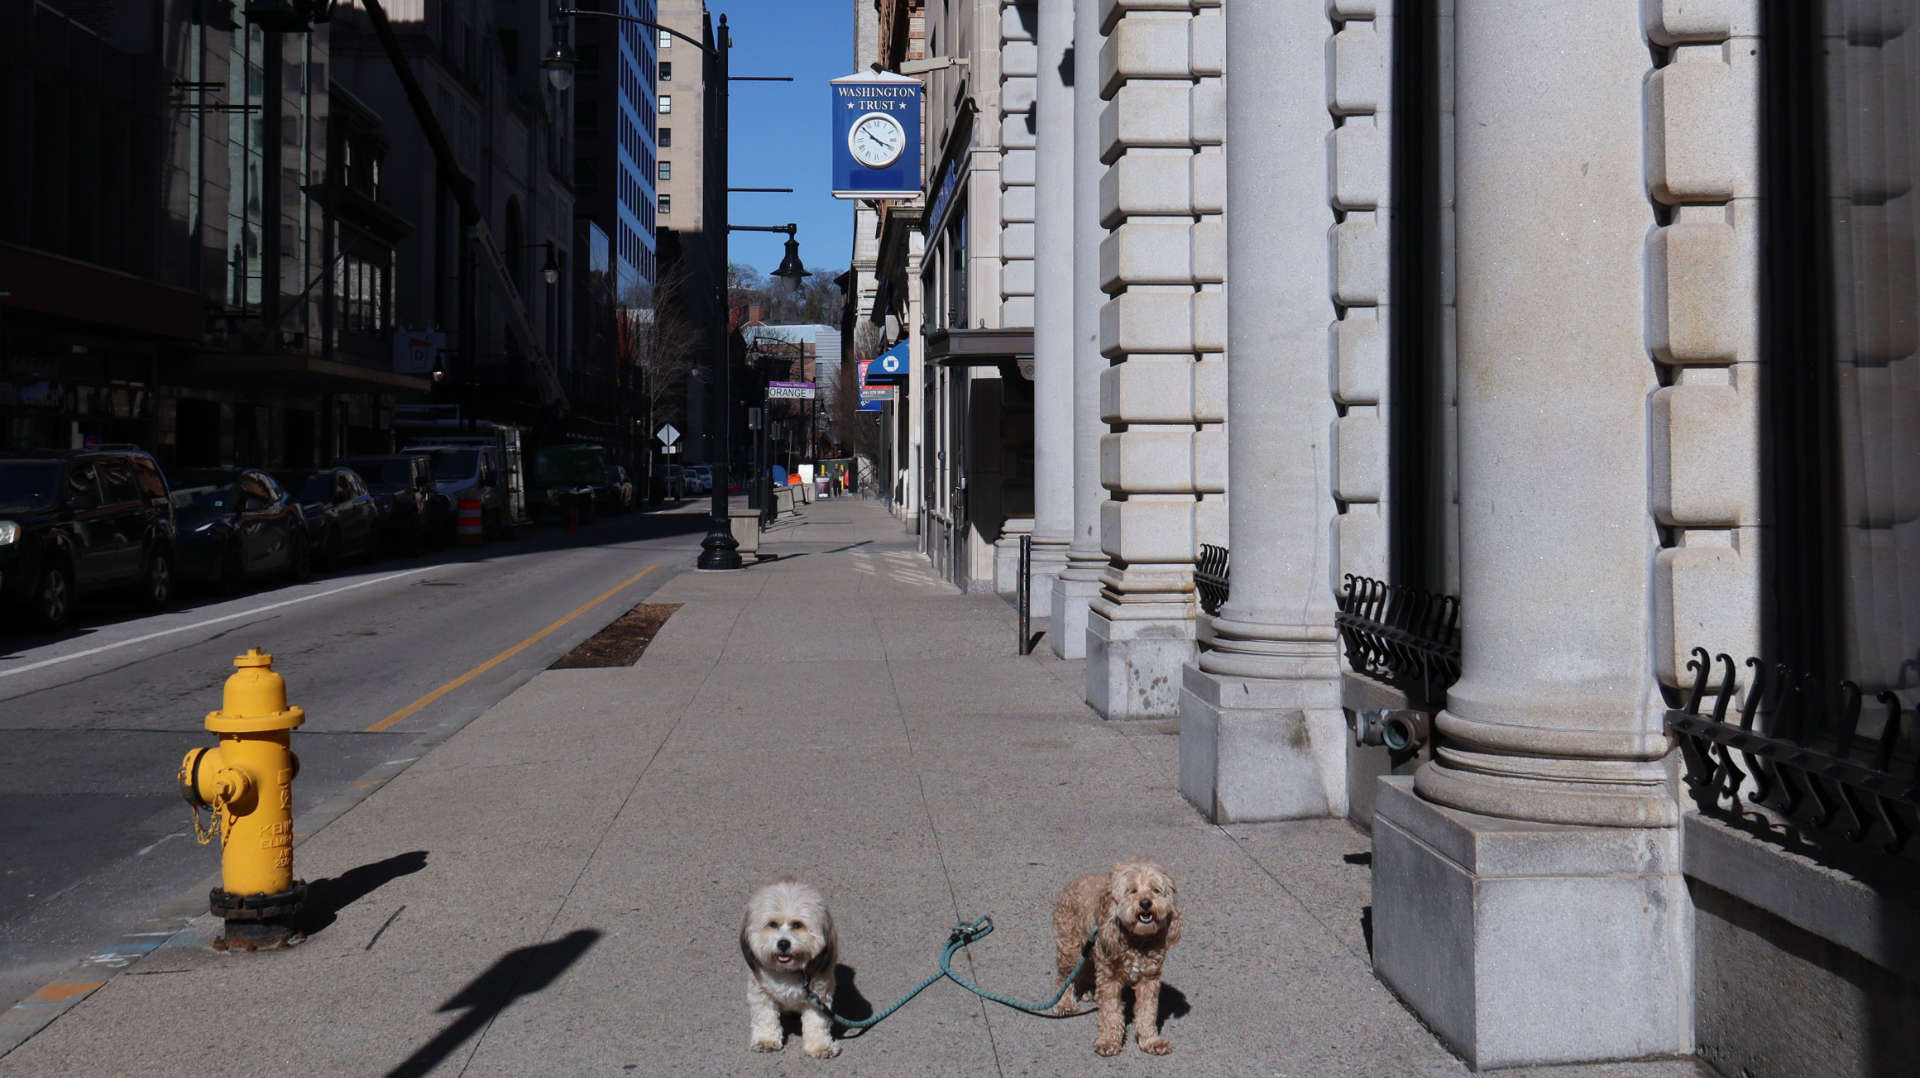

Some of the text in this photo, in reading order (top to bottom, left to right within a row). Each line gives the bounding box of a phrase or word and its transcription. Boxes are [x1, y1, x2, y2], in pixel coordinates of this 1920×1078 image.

[838, 87, 916, 97] WASHINGTON
[859, 100, 896, 110] TRUST
[769, 387, 807, 398] ORANGE
